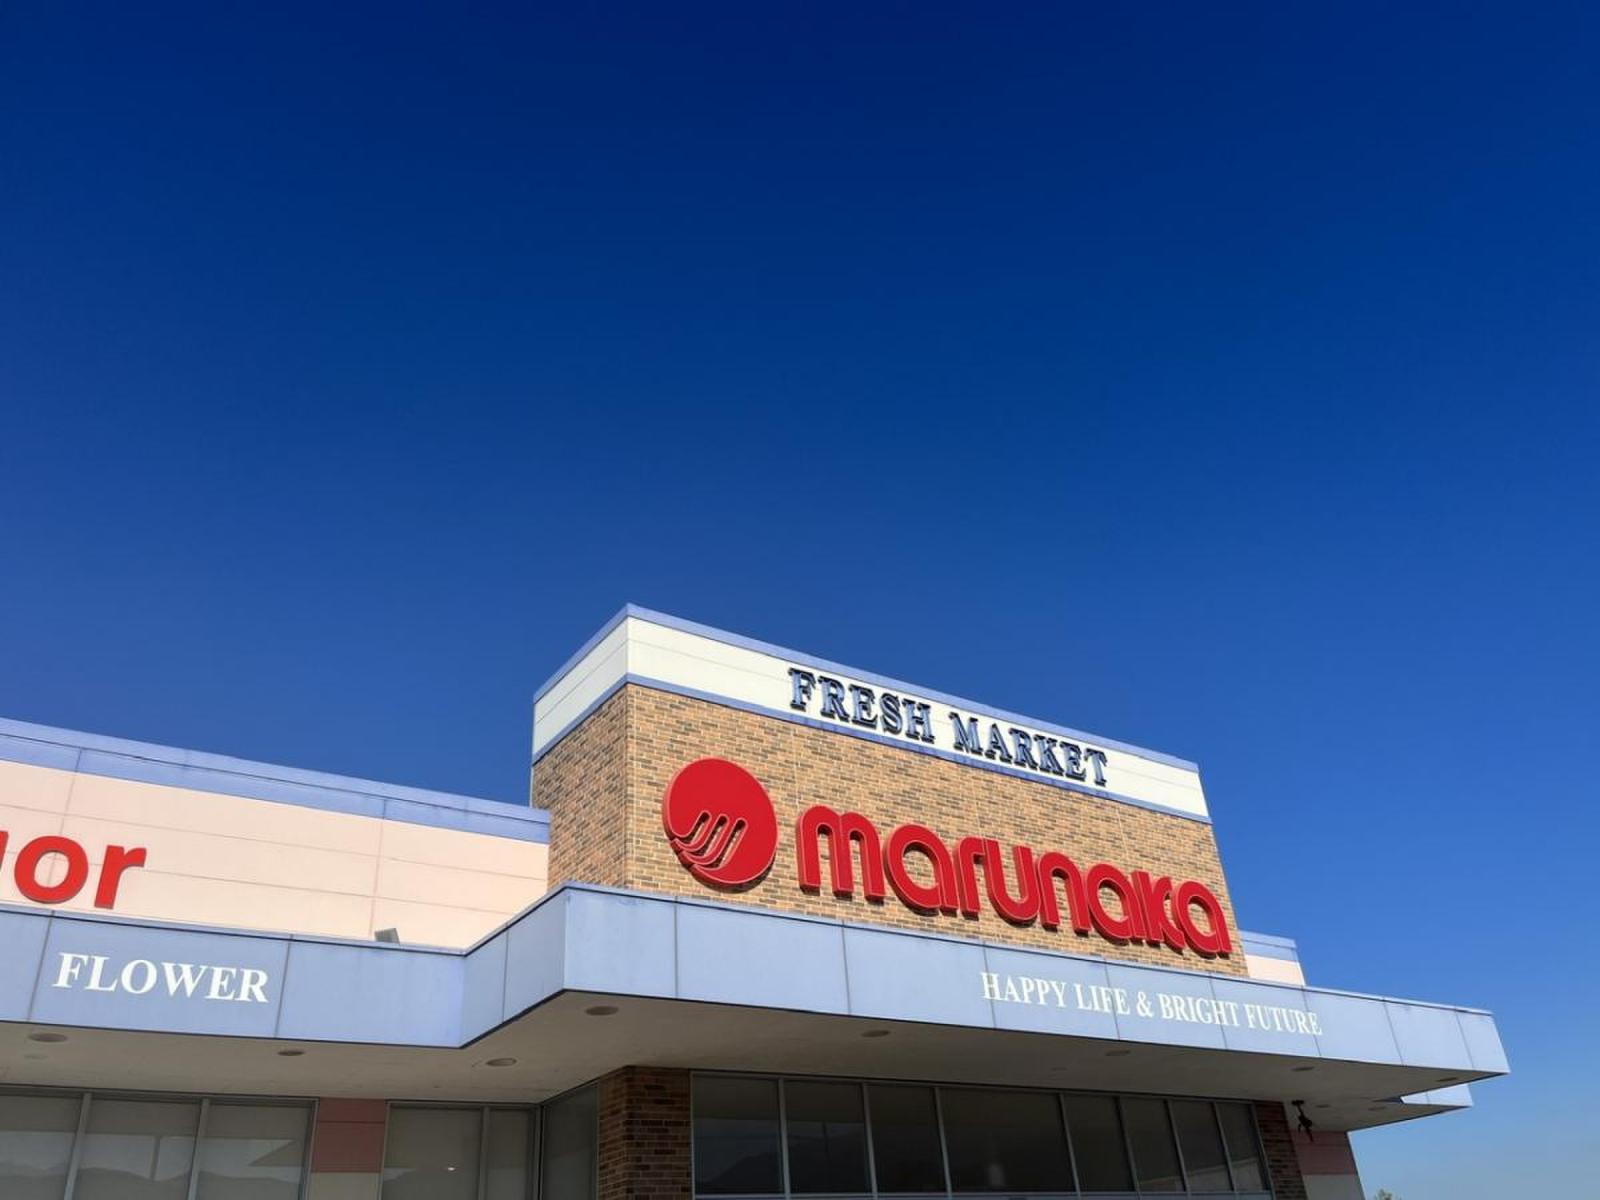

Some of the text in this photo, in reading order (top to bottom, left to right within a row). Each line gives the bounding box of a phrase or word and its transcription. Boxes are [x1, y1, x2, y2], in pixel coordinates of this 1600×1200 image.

[788, 667, 1108, 787] FRESH MARKET
[0, 830, 147, 910] or
[796, 804, 1232, 957] marunaka
[52, 952, 269, 1003] FLOWER
[979, 971, 1323, 1036] HAPPY LIFE & BRIGHT FUTURE
